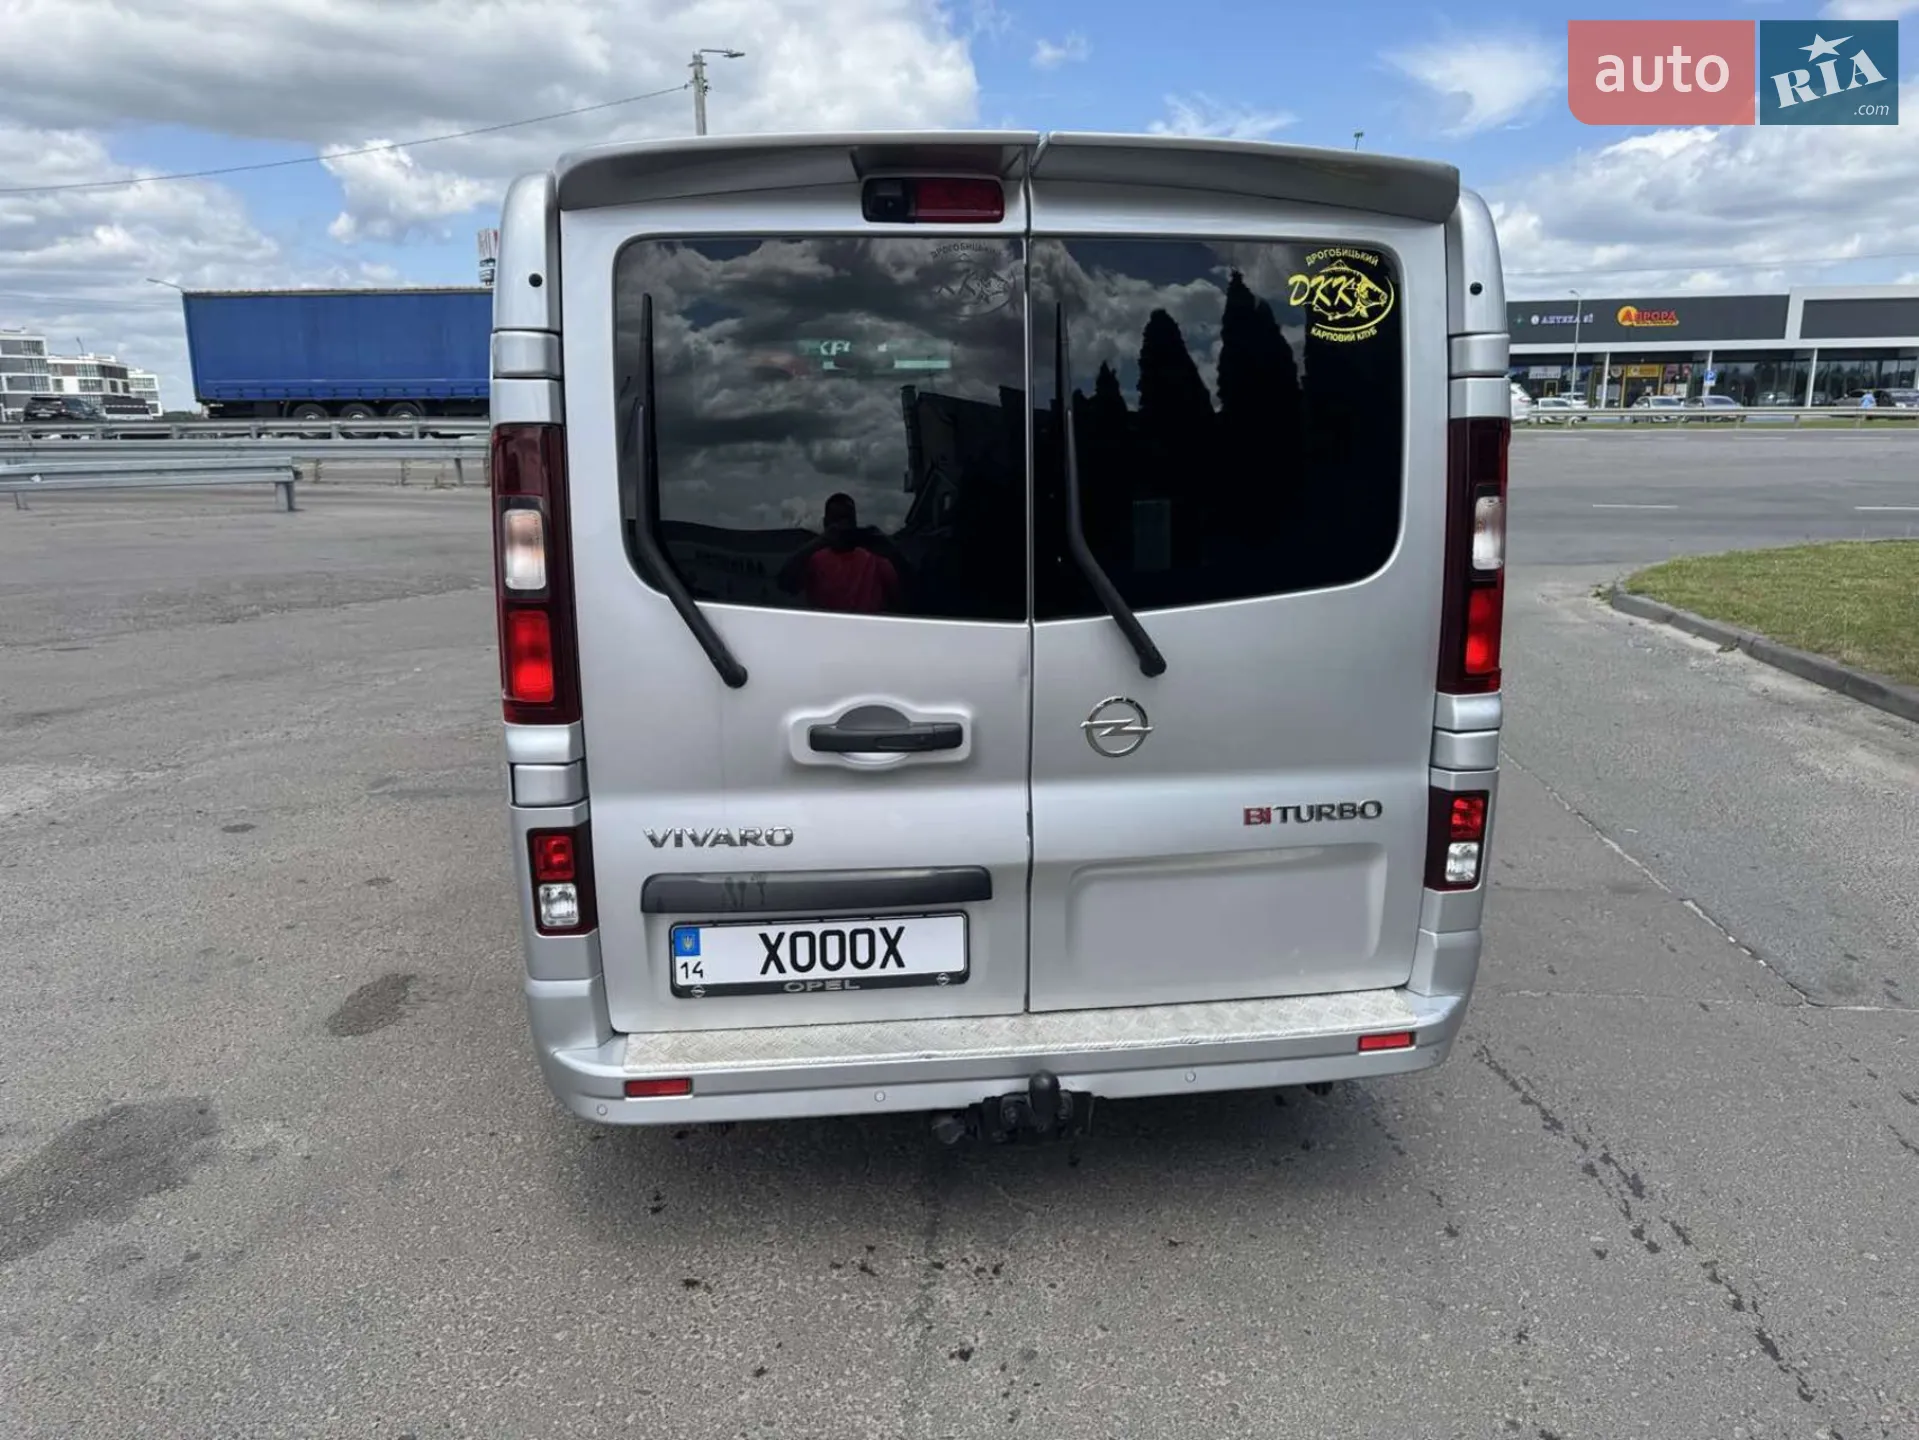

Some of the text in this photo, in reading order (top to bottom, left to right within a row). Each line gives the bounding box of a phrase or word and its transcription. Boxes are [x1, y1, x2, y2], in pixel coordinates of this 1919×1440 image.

[1305, 248, 1379, 267] ДРОГОБИЦЬКИЙ
[1310, 325, 1378, 342] КАРПОВИЙ КЛУБ
[643, 826, 794, 848] VIVARO
[680, 960, 704, 979] 14
[784, 979, 860, 992] OPEL
